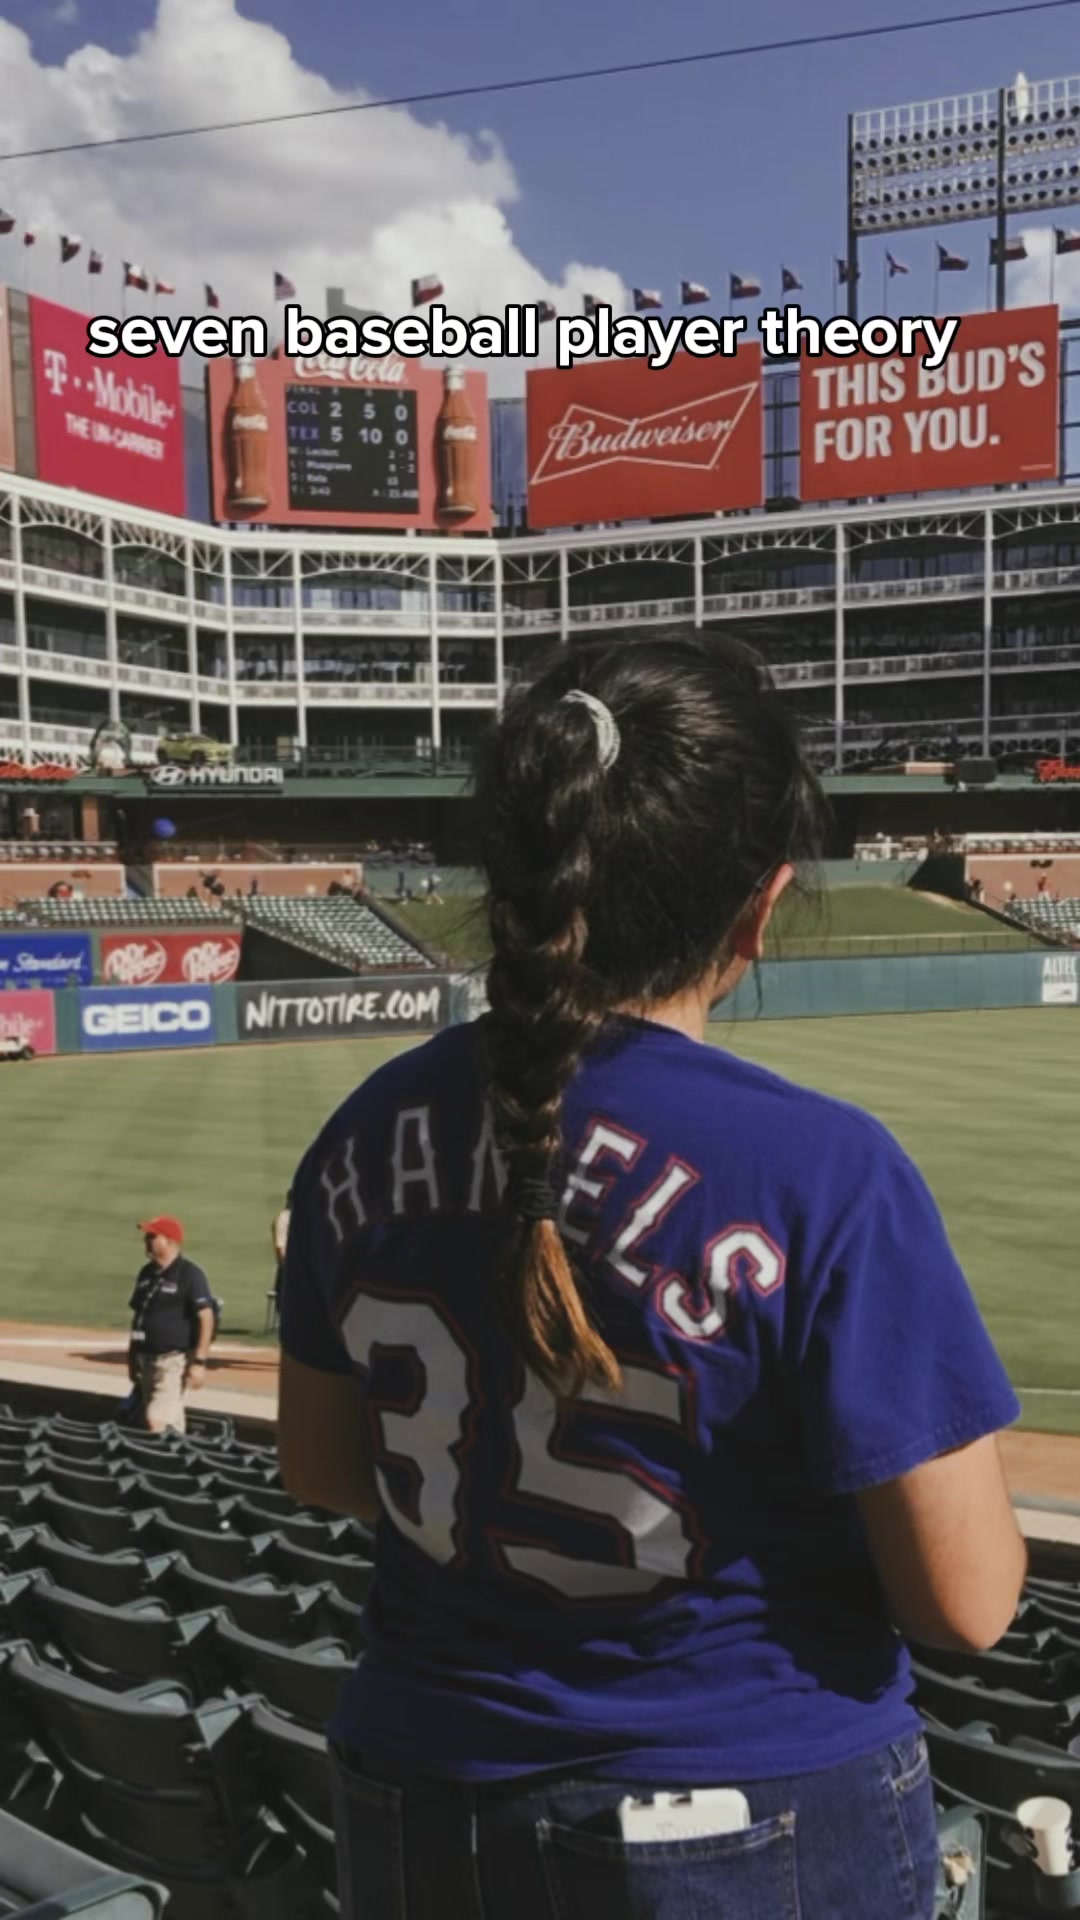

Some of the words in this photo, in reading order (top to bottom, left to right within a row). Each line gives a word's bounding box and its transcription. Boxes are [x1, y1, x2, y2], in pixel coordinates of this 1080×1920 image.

[811, 358, 906, 410] THIS
[917, 340, 1046, 399] BUD'S
[64, 411, 90, 440] THE
[287, 401, 320, 415] COL
[329, 401, 342, 418] 2
[363, 403, 376, 419] 5
[394, 404, 408, 422] 0
[289, 426, 320, 440] TEX
[330, 426, 343, 442] 5
[359, 427, 383, 444] 10
[395, 428, 409, 445] 0
[548, 417, 733, 461] Budweiser
[814, 414, 892, 464] FOR
[903, 403, 1001, 454] YOU.
[190, 765, 284, 784] HYUNDAI
[82, 1000, 212, 1037] GEICO
[246, 985, 441, 1031] NITTOTIRE.COM
[337, 1283, 707, 1606] 35
